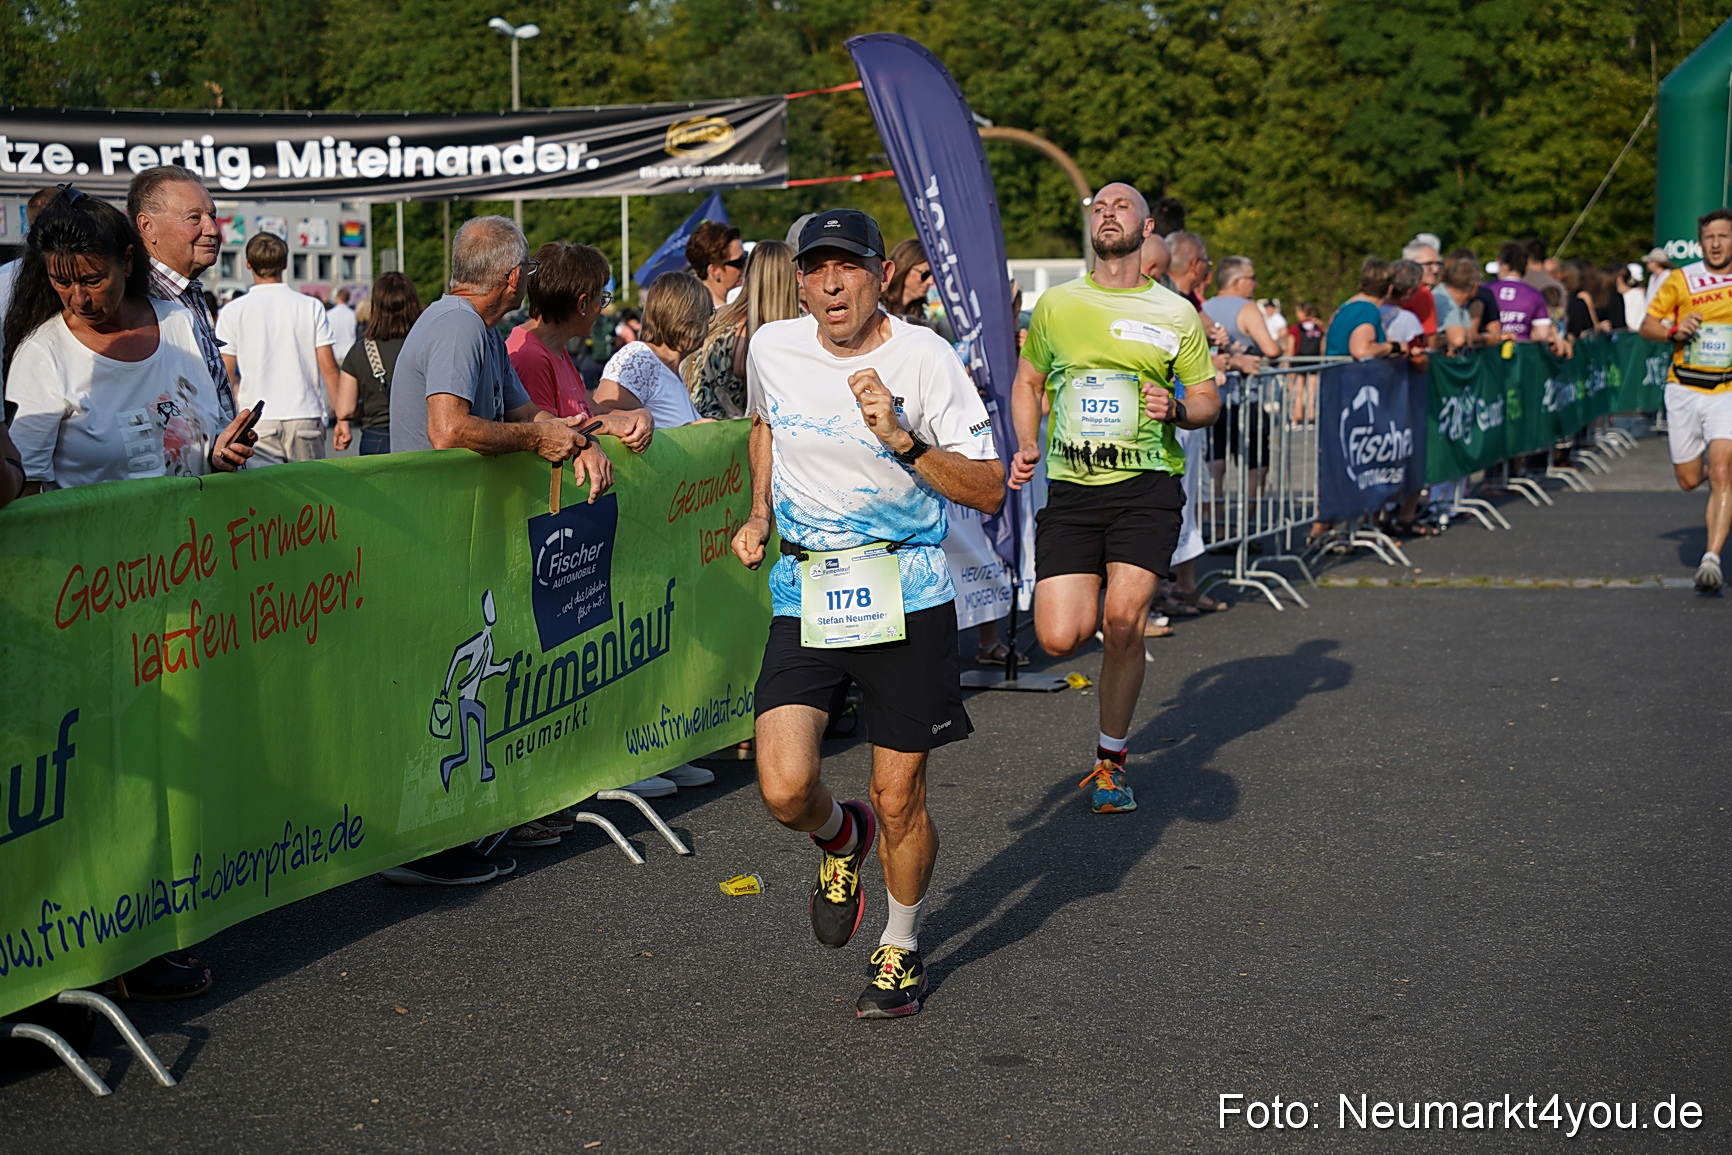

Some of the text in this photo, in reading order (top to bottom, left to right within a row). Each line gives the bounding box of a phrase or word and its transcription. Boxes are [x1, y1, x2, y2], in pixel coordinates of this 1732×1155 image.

[99, 134, 267, 192] Fertig.
[276, 135, 600, 179] Miteinander.
[1692, 291, 1723, 306] MAX
[1081, 398, 1119, 414] 1375
[227, 503, 339, 570] Firmen
[549, 541, 605, 578] Fischer
[961, 562, 995, 584] HEUTE
[552, 563, 597, 590] AUTOMOBILE
[826, 587, 872, 611] 1178
[132, 546, 364, 687] laufen länger!
[817, 615, 845, 626] Stefan
[502, 576, 676, 732] firmenlauf
[505, 701, 589, 767] neumarkt
